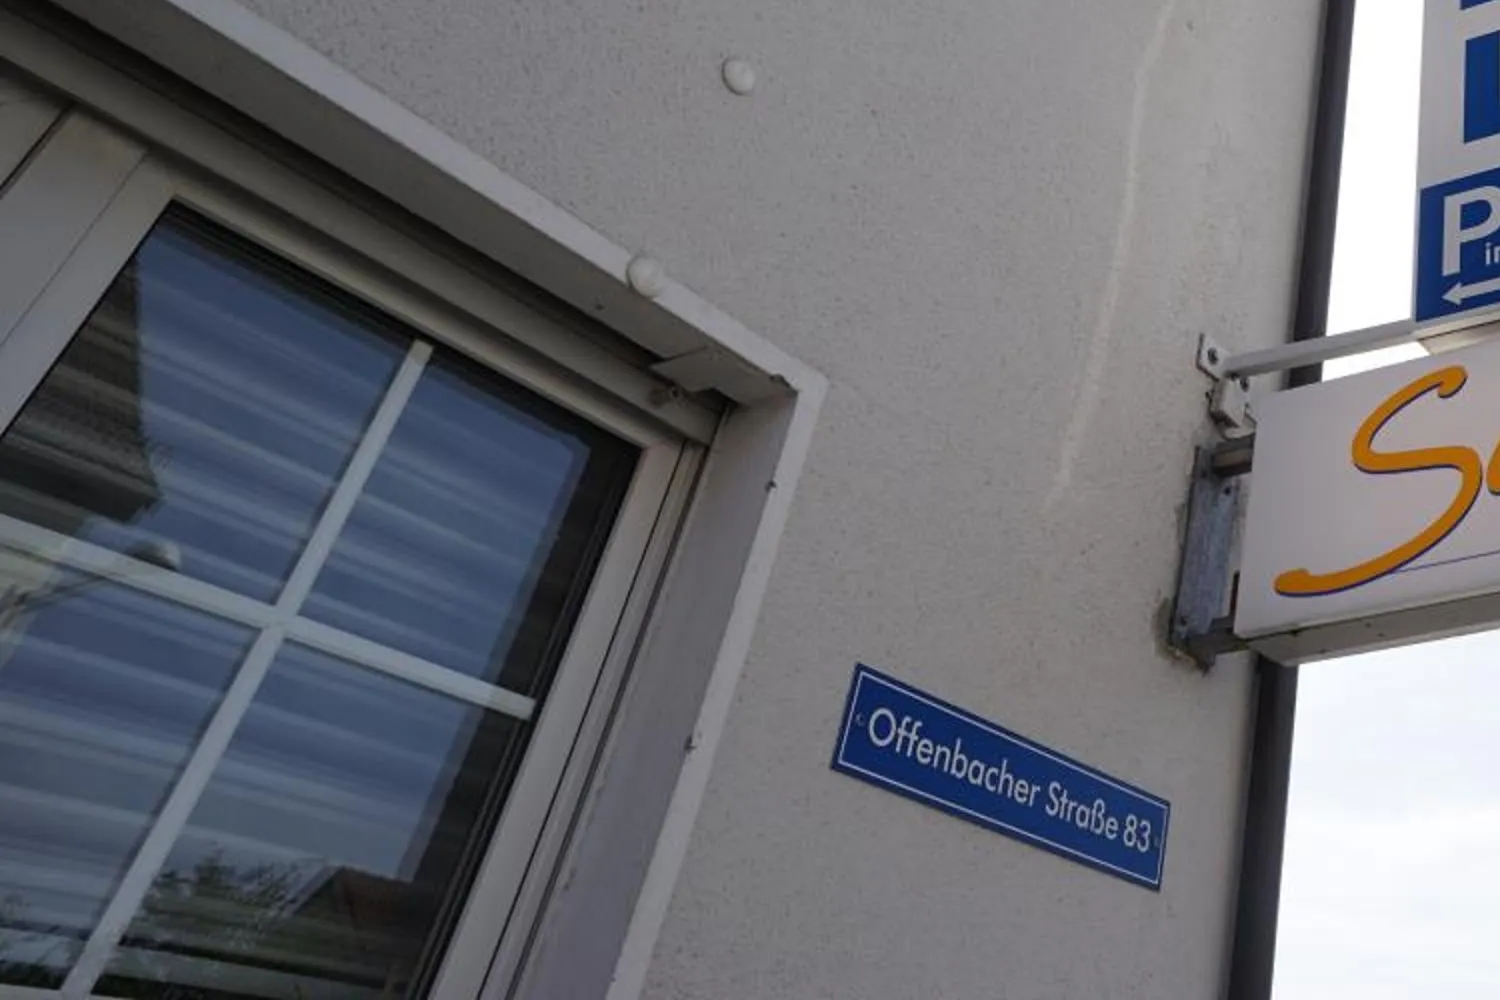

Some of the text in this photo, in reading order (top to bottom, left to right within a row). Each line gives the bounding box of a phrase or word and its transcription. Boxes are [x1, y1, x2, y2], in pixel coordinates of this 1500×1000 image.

[868, 707, 1152, 853] Offenbacher Straße 83
